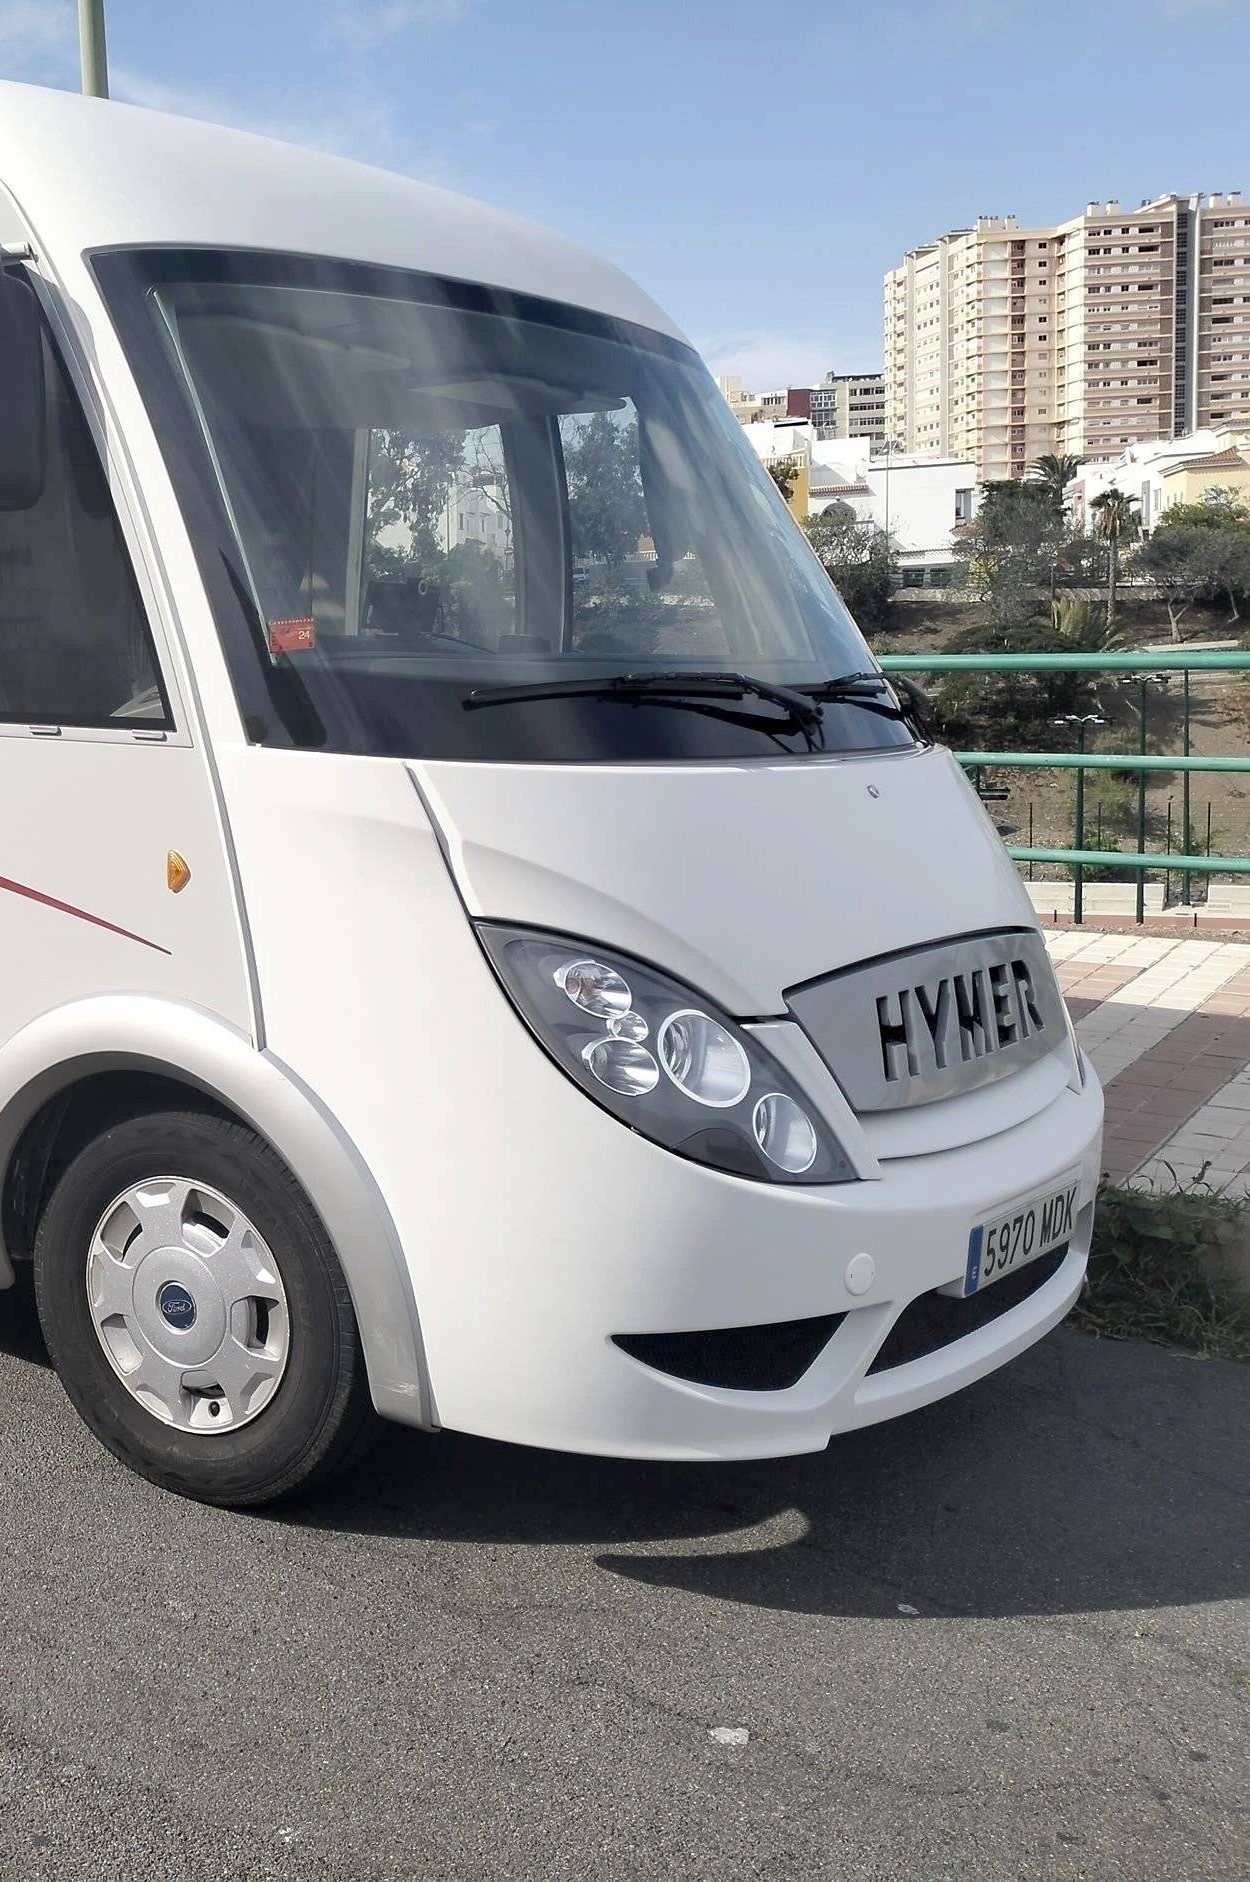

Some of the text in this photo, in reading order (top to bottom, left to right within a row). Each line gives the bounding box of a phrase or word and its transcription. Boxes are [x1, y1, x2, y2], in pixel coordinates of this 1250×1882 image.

[298, 630, 311, 640] 24
[876, 960, 1045, 1082] HYMER
[984, 1186, 1077, 1277] 5970 MDK
[167, 1301, 186, 1313] Ford
